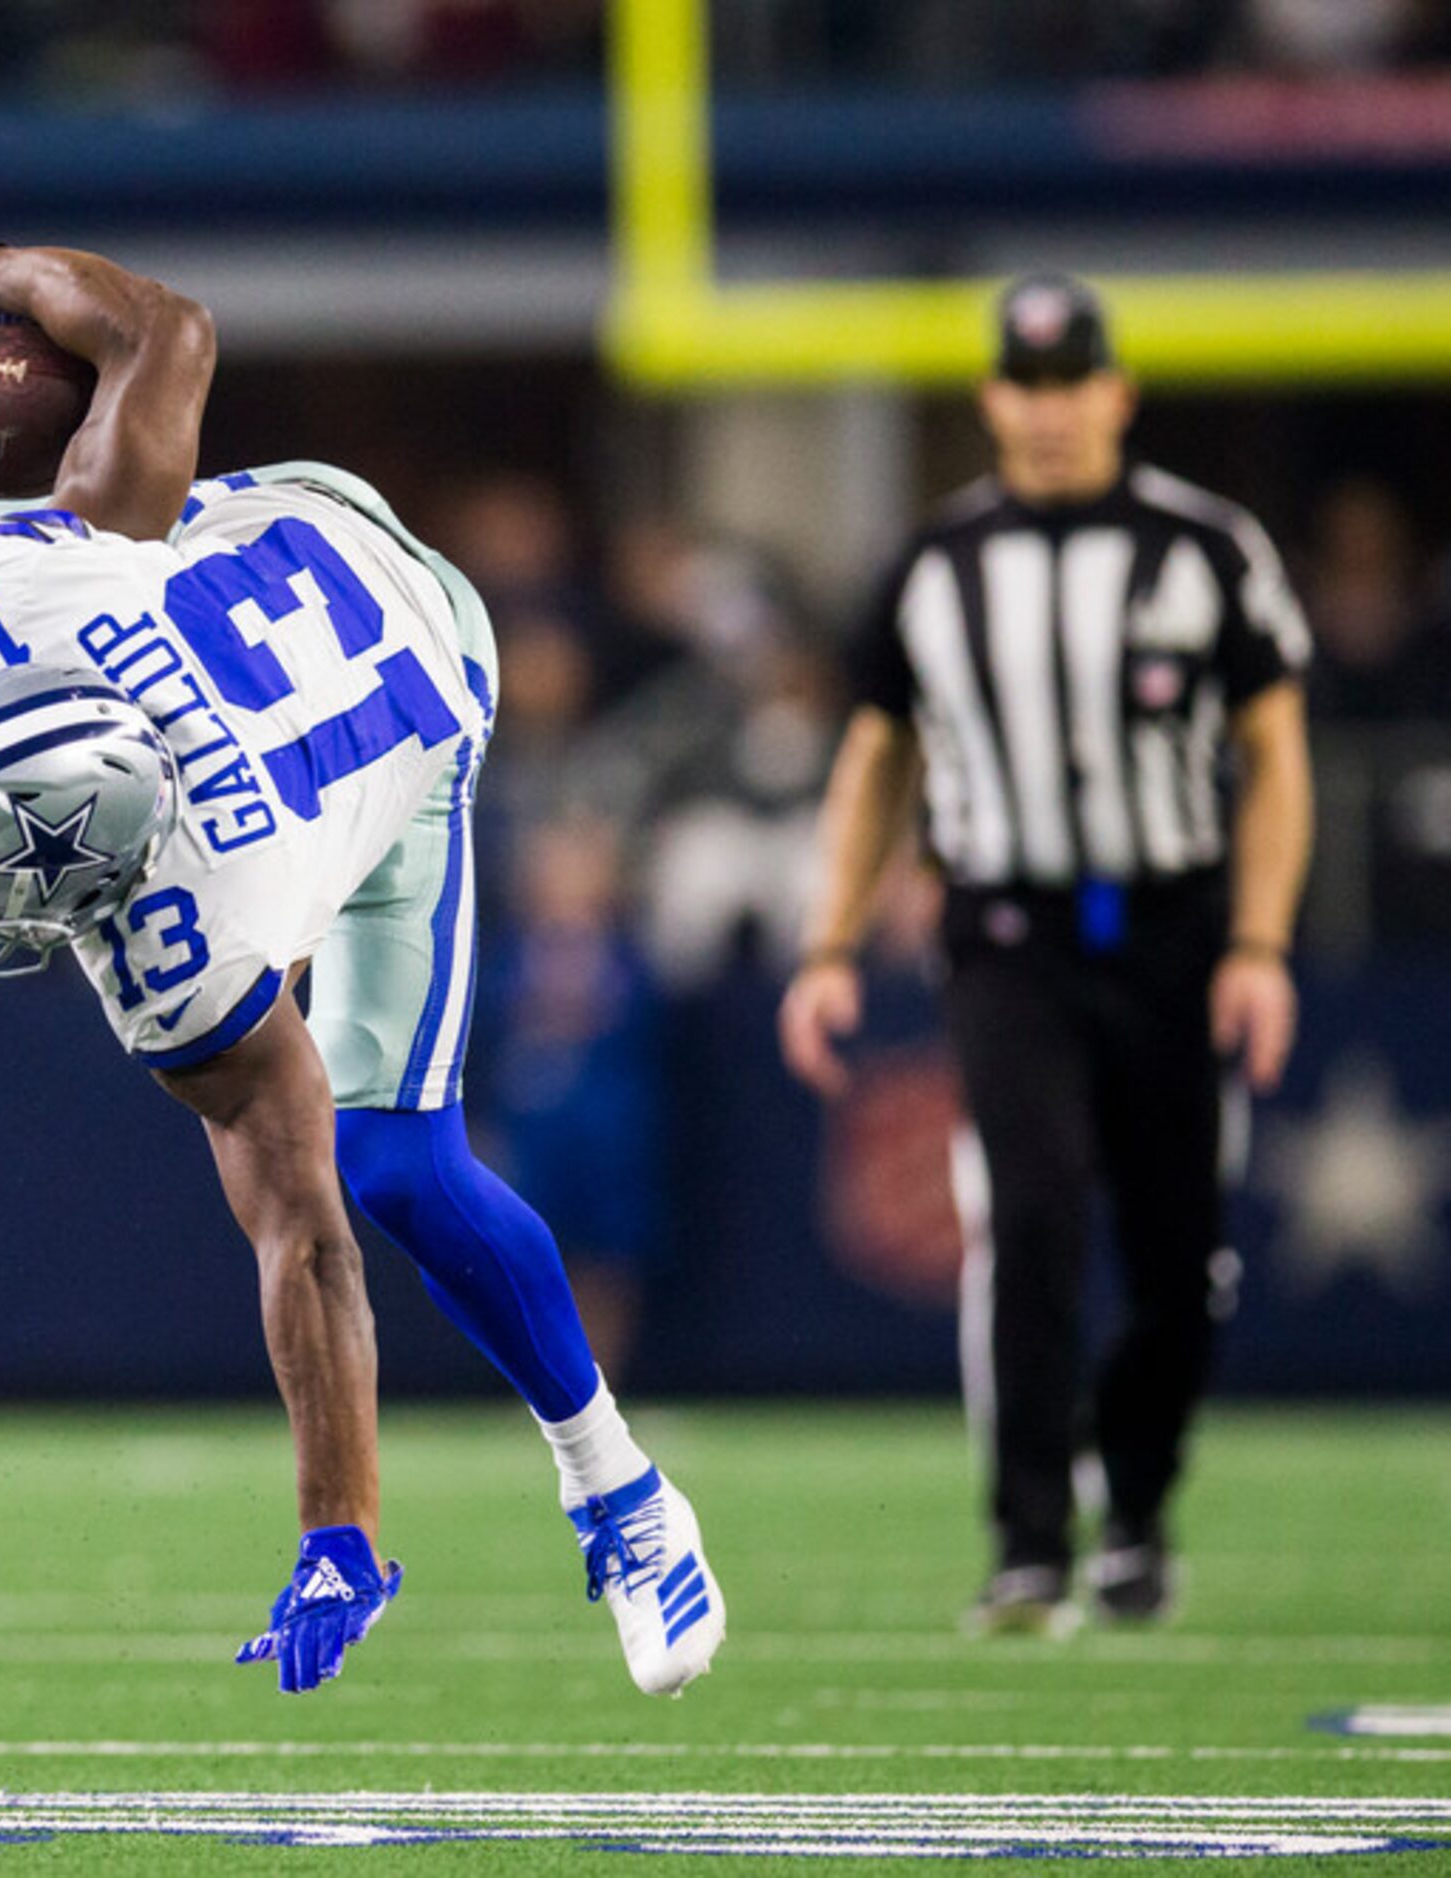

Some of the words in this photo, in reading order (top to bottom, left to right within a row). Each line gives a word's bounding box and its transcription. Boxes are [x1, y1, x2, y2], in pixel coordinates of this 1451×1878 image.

[77, 611, 277, 853] GALLUP
[163, 516, 462, 822] 13
[100, 885, 210, 1012] 13
